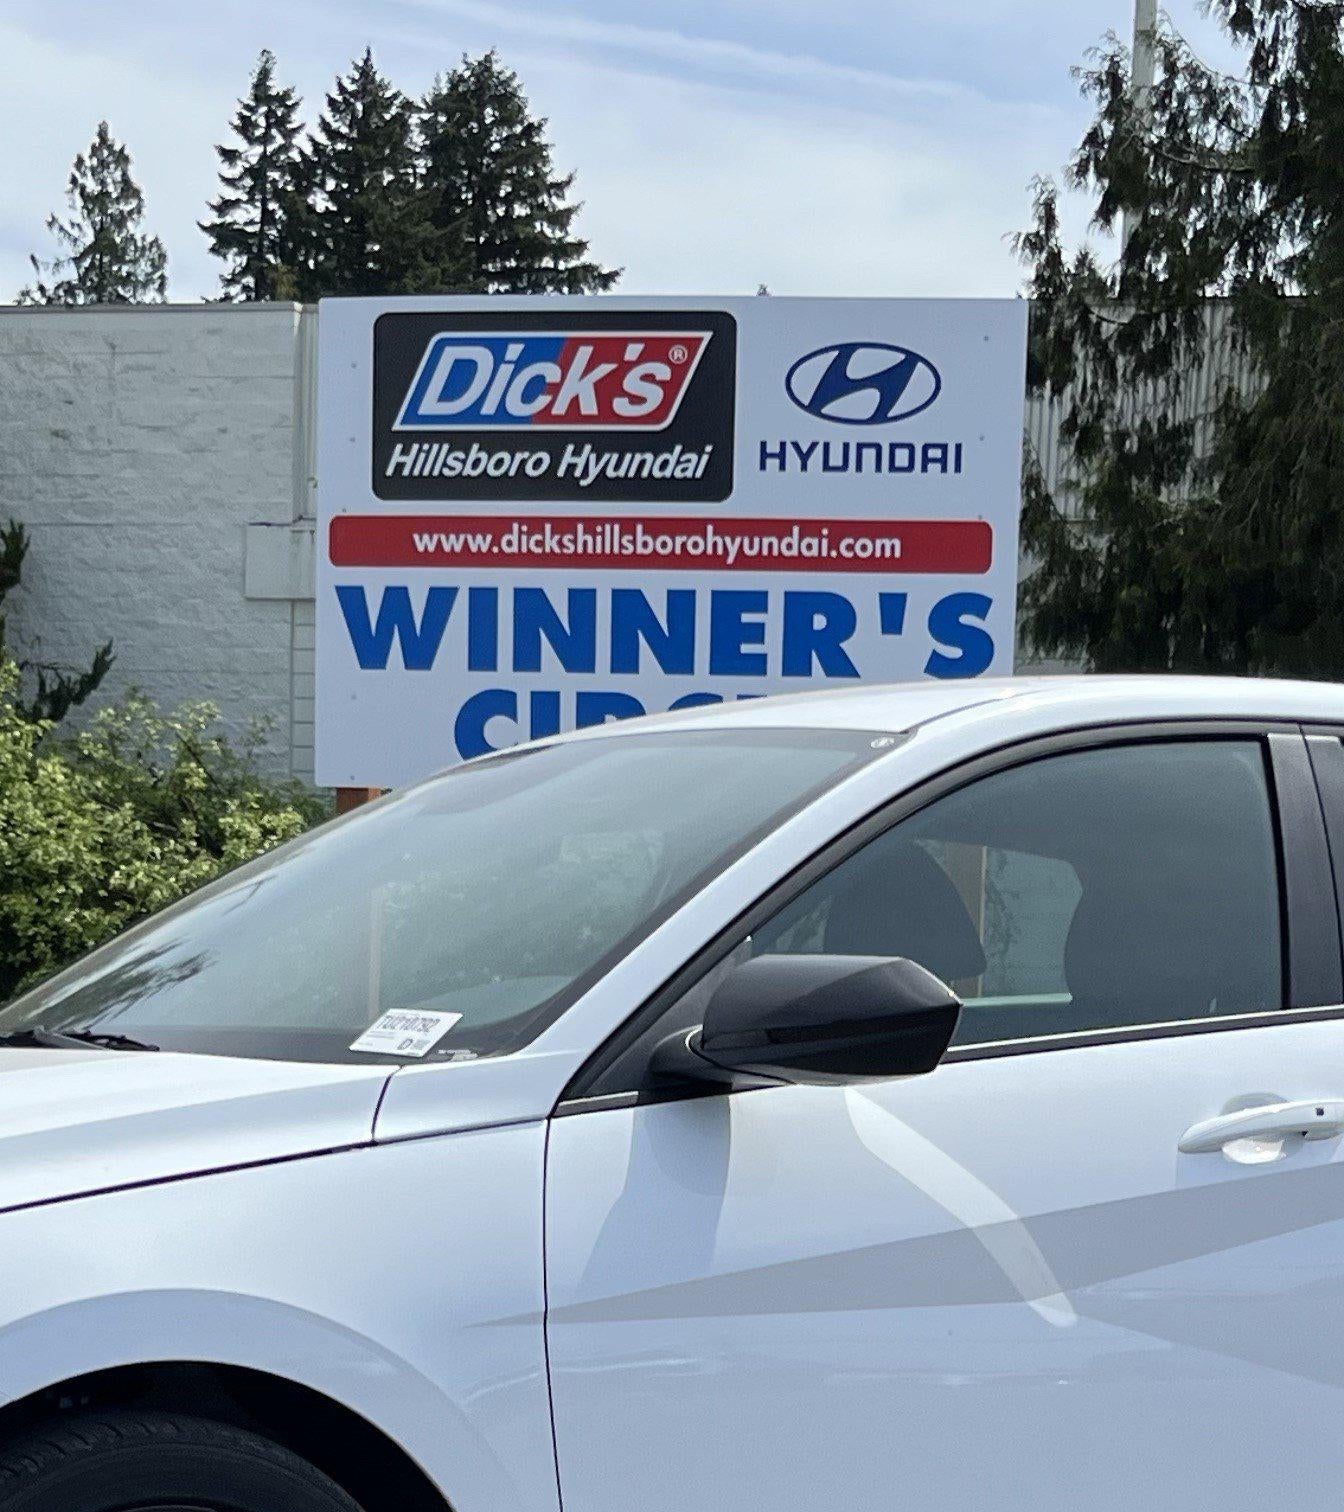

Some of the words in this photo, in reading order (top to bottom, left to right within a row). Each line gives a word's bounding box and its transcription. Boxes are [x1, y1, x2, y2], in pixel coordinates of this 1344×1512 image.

[385, 443, 551, 479] Hillsboro
[557, 443, 713, 487] Hyundai
[759, 440, 963, 474] HYUNDAI
[413, 523, 902, 566] www.dickshillsborohyundai.com
[335, 584, 995, 679] WINNER'S
